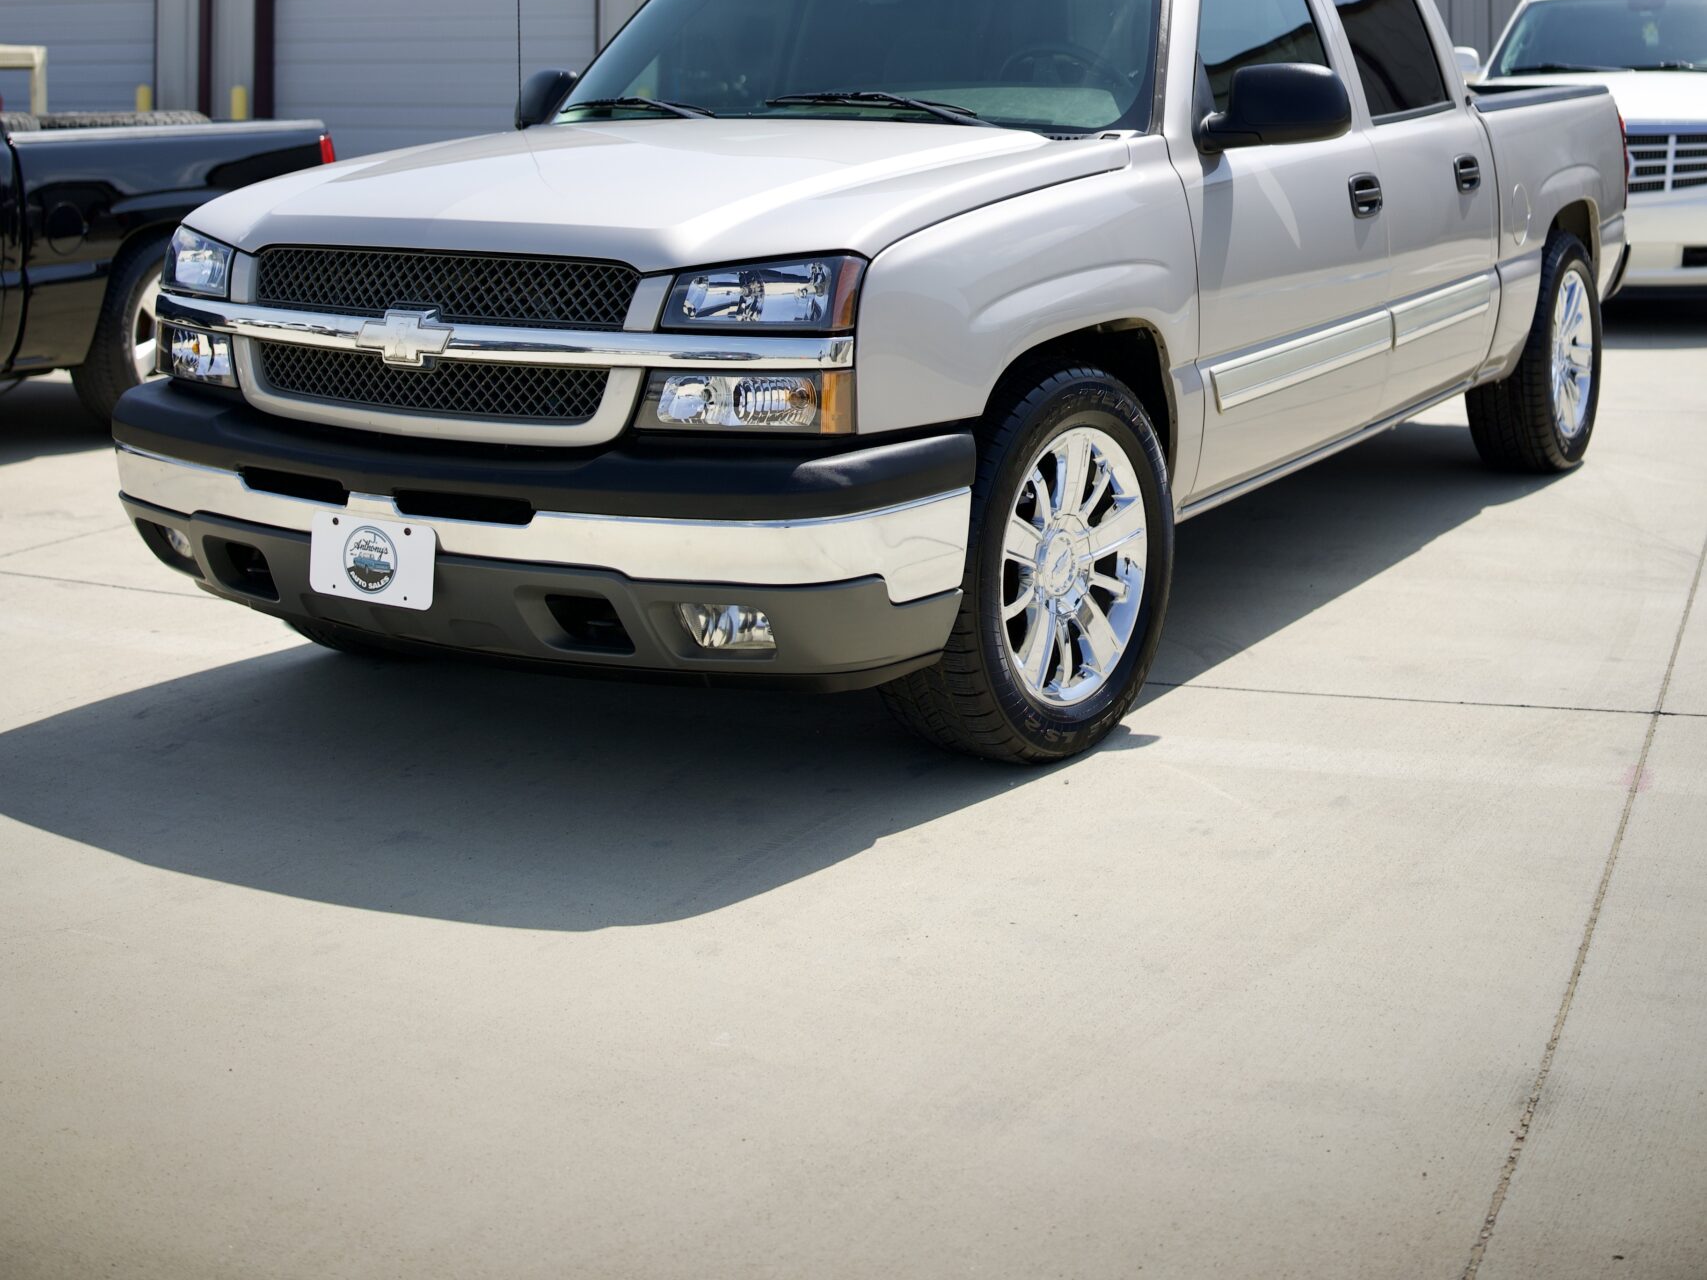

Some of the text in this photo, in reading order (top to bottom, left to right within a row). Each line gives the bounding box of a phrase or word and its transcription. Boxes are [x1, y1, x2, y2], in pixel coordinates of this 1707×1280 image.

[350, 538, 389, 561] Anthony's
[350, 571, 390, 590] AUTO SALES
